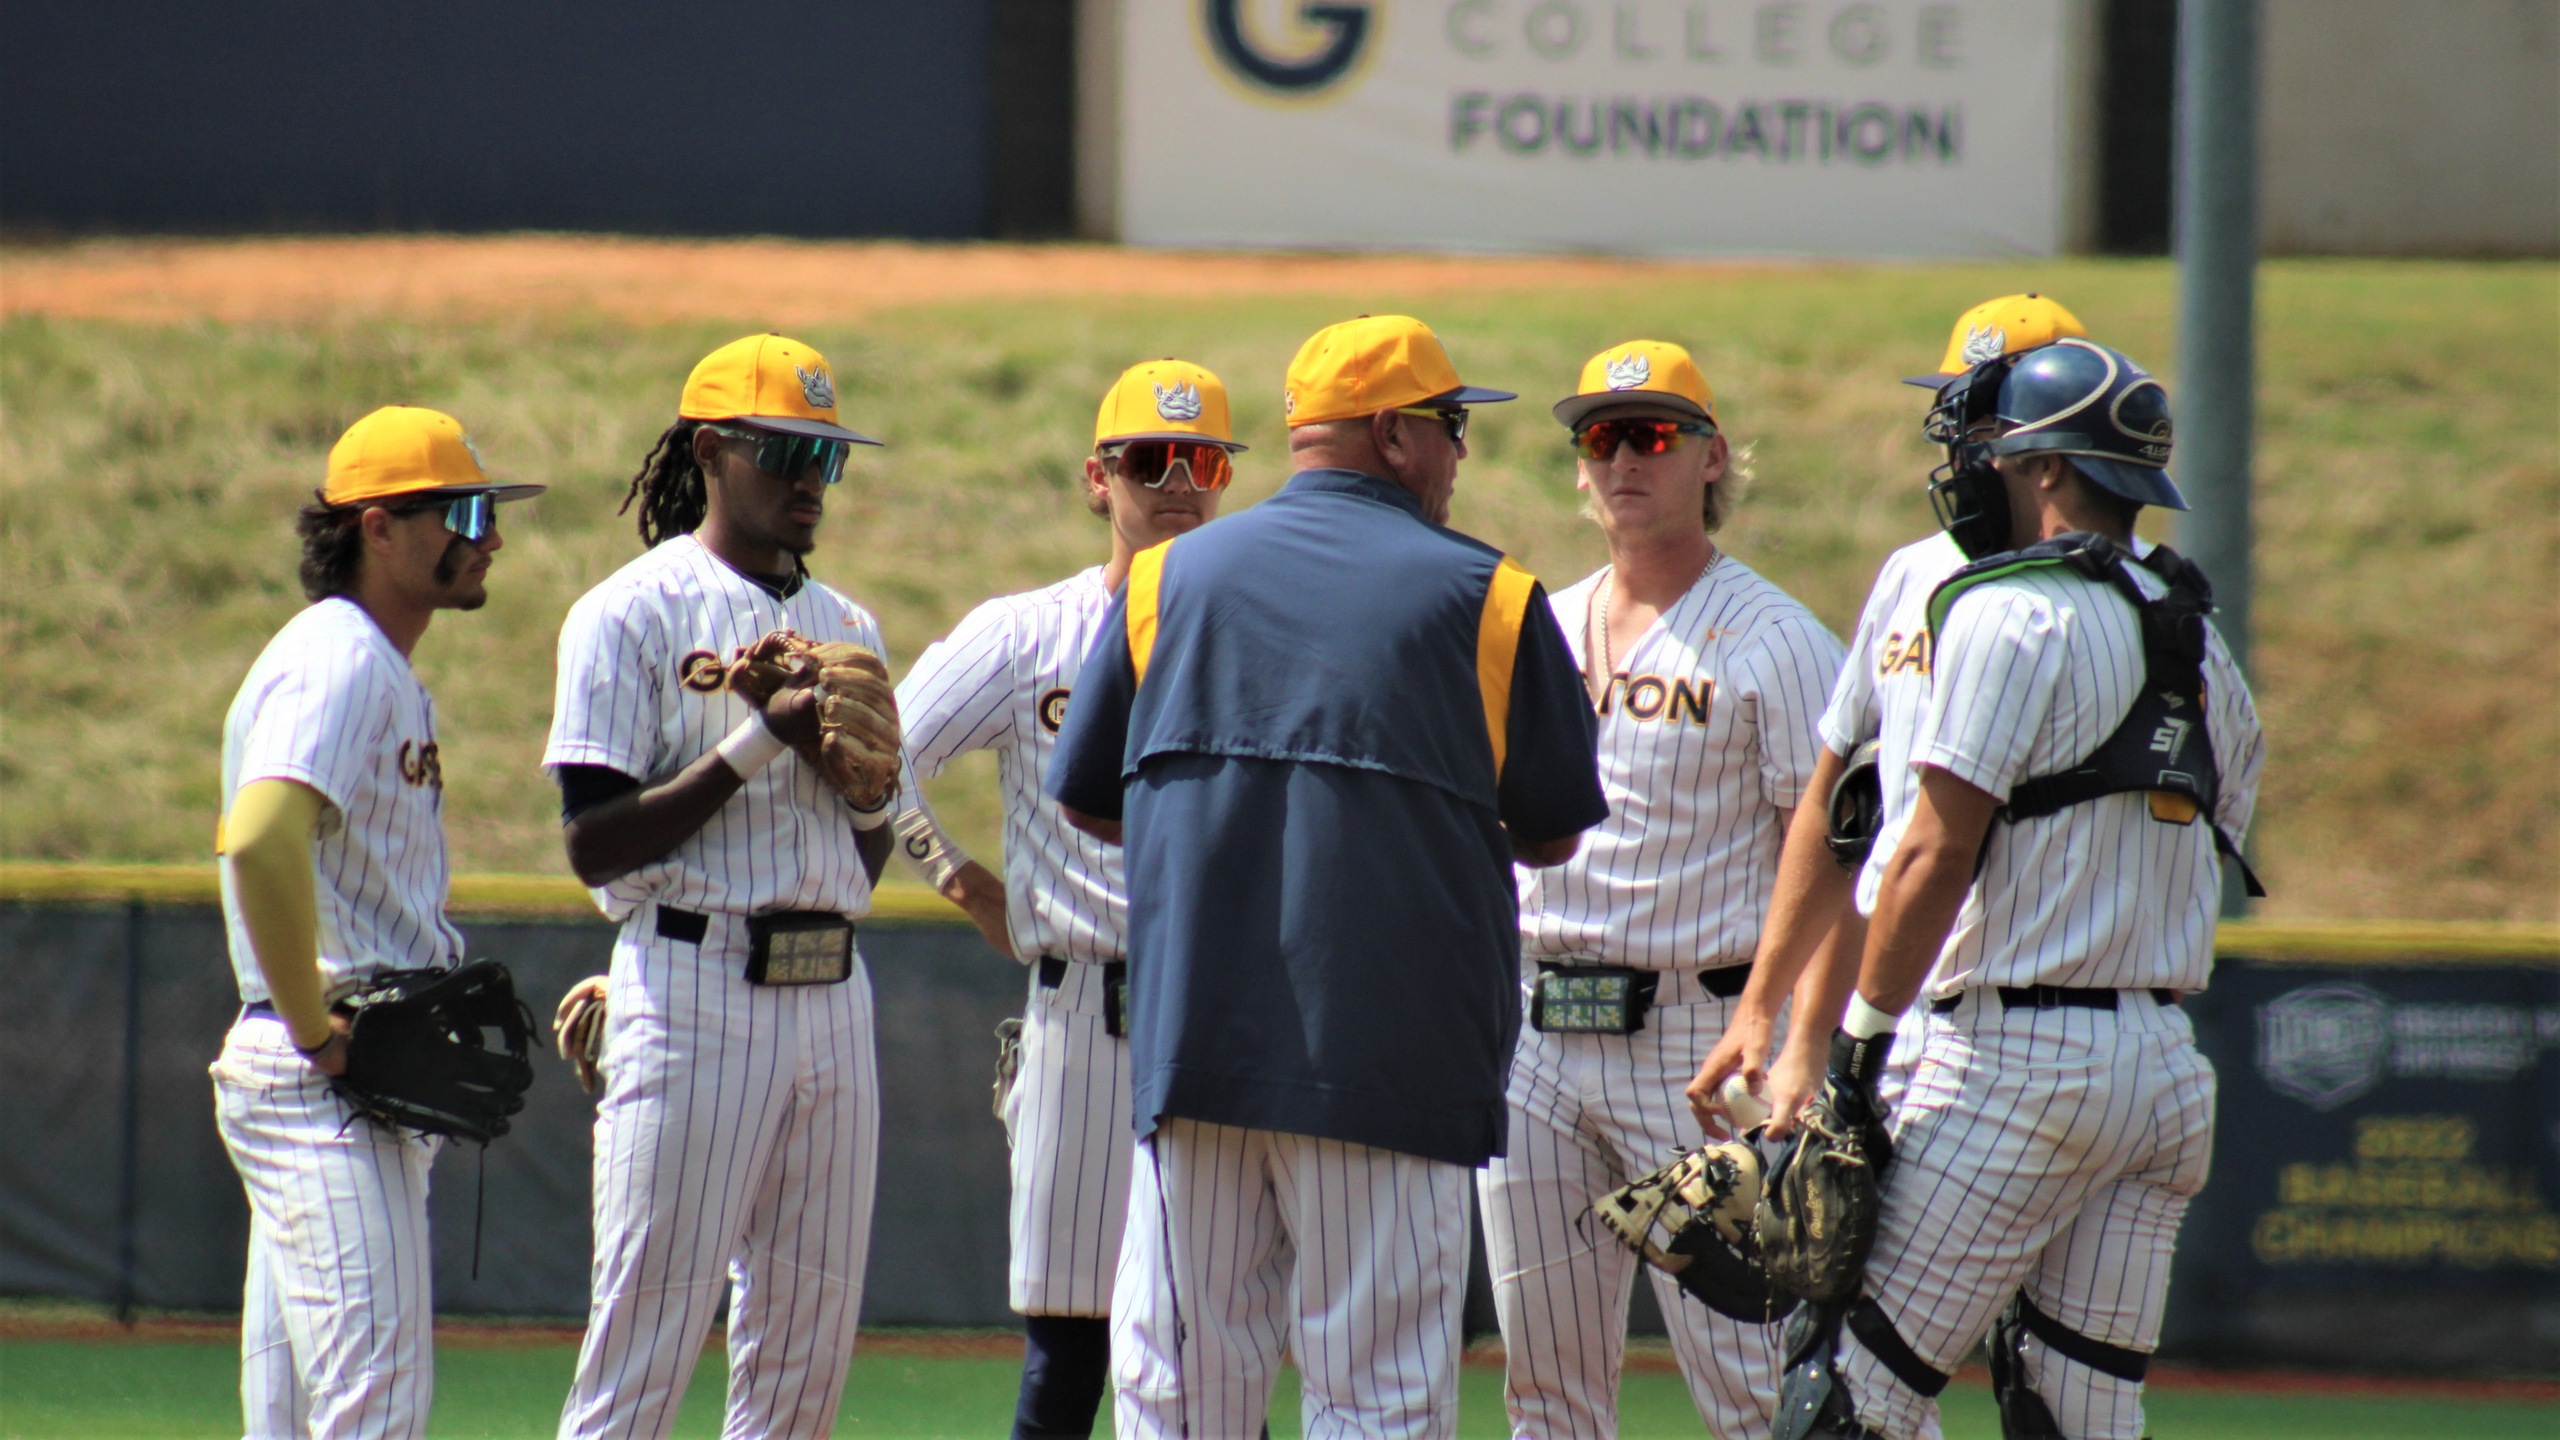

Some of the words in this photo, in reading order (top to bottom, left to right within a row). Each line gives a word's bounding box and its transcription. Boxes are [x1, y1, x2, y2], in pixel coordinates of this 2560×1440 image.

[1447, 0, 1971, 70] COLLEGE
[1449, 92, 1964, 165] FOUNDATION
[1879, 629, 1932, 678] GA
[1579, 670, 1716, 726] TON
[2253, 1207, 2560, 1266] CHAMPIONS
